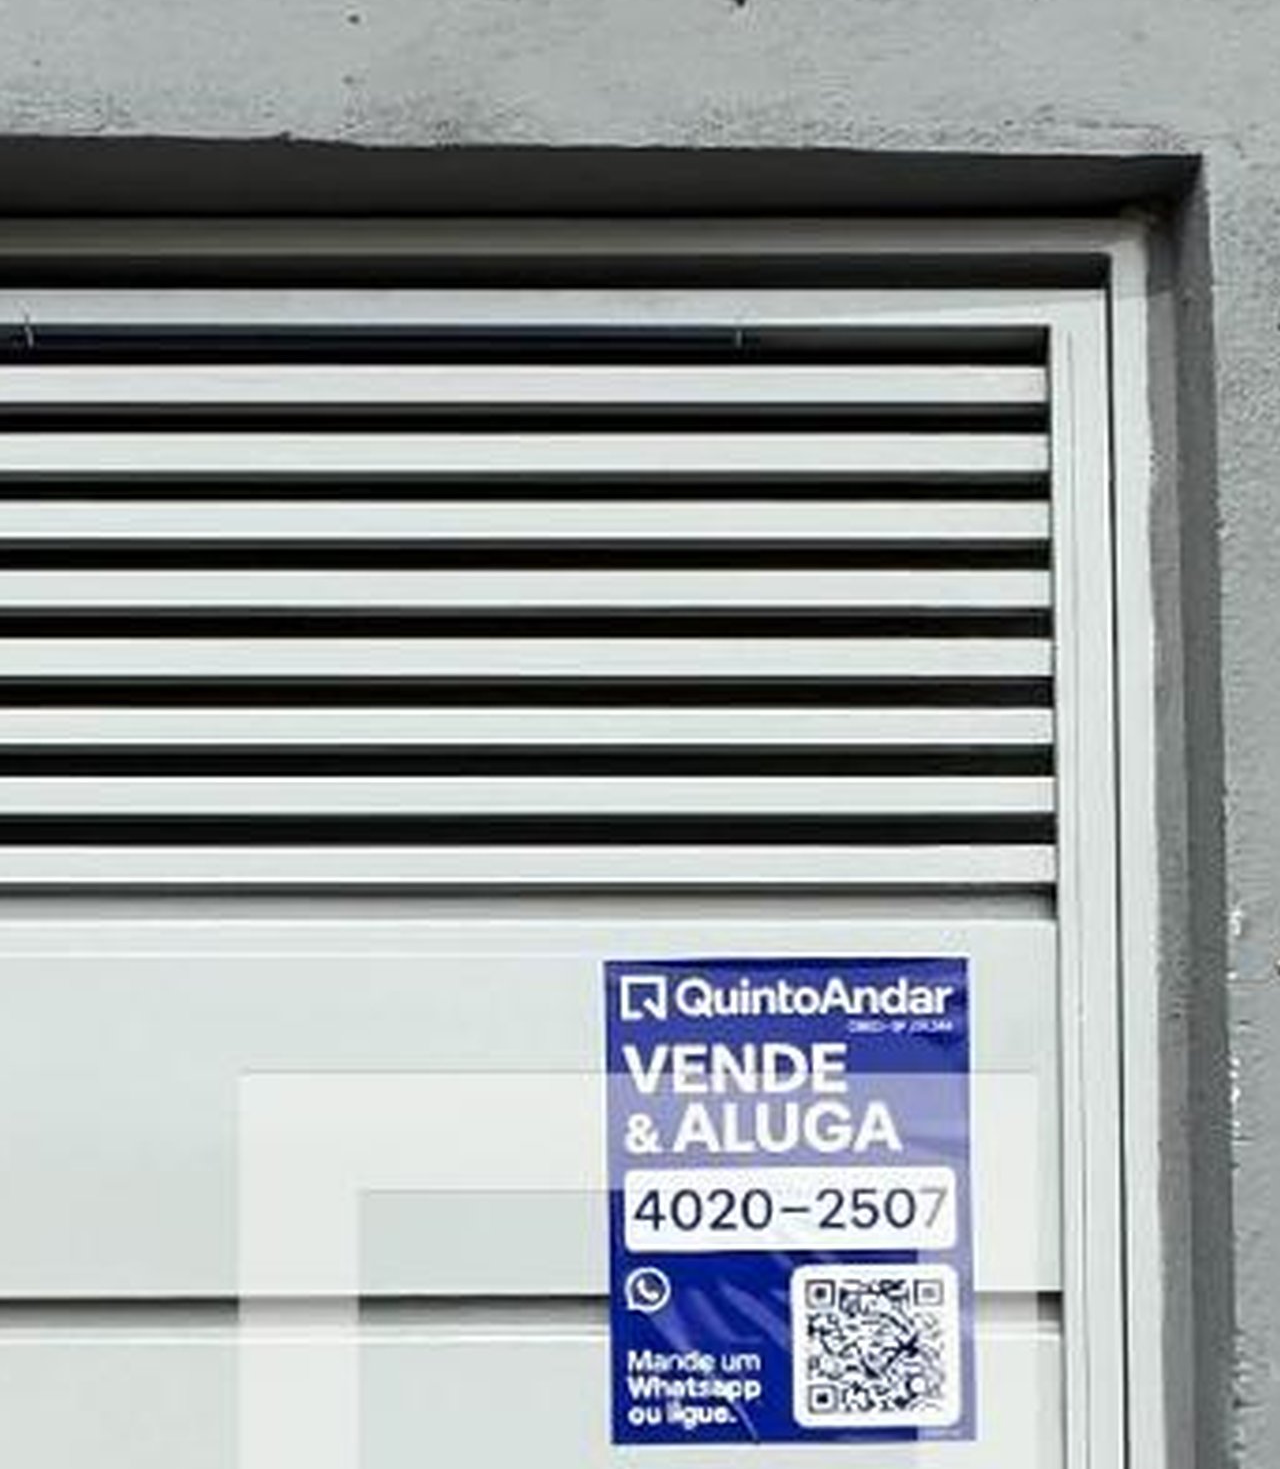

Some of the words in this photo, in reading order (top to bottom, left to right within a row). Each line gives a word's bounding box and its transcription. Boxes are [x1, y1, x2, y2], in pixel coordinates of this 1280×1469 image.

[675, 976, 954, 1018] QuintoAndar
[621, 1042, 847, 1094] VENDE
[625, 1112, 662, 1154] &
[673, 1101, 903, 1153] ALUGA
[633, 1186, 949, 1231] 4020-2507
[628, 1349, 715, 1372] Mande
[721, 1353, 761, 1372] um
[627, 1375, 761, 1401] Whatsapp
[627, 1405, 662, 1426] ou
[667, 1400, 737, 1430] ligue.
